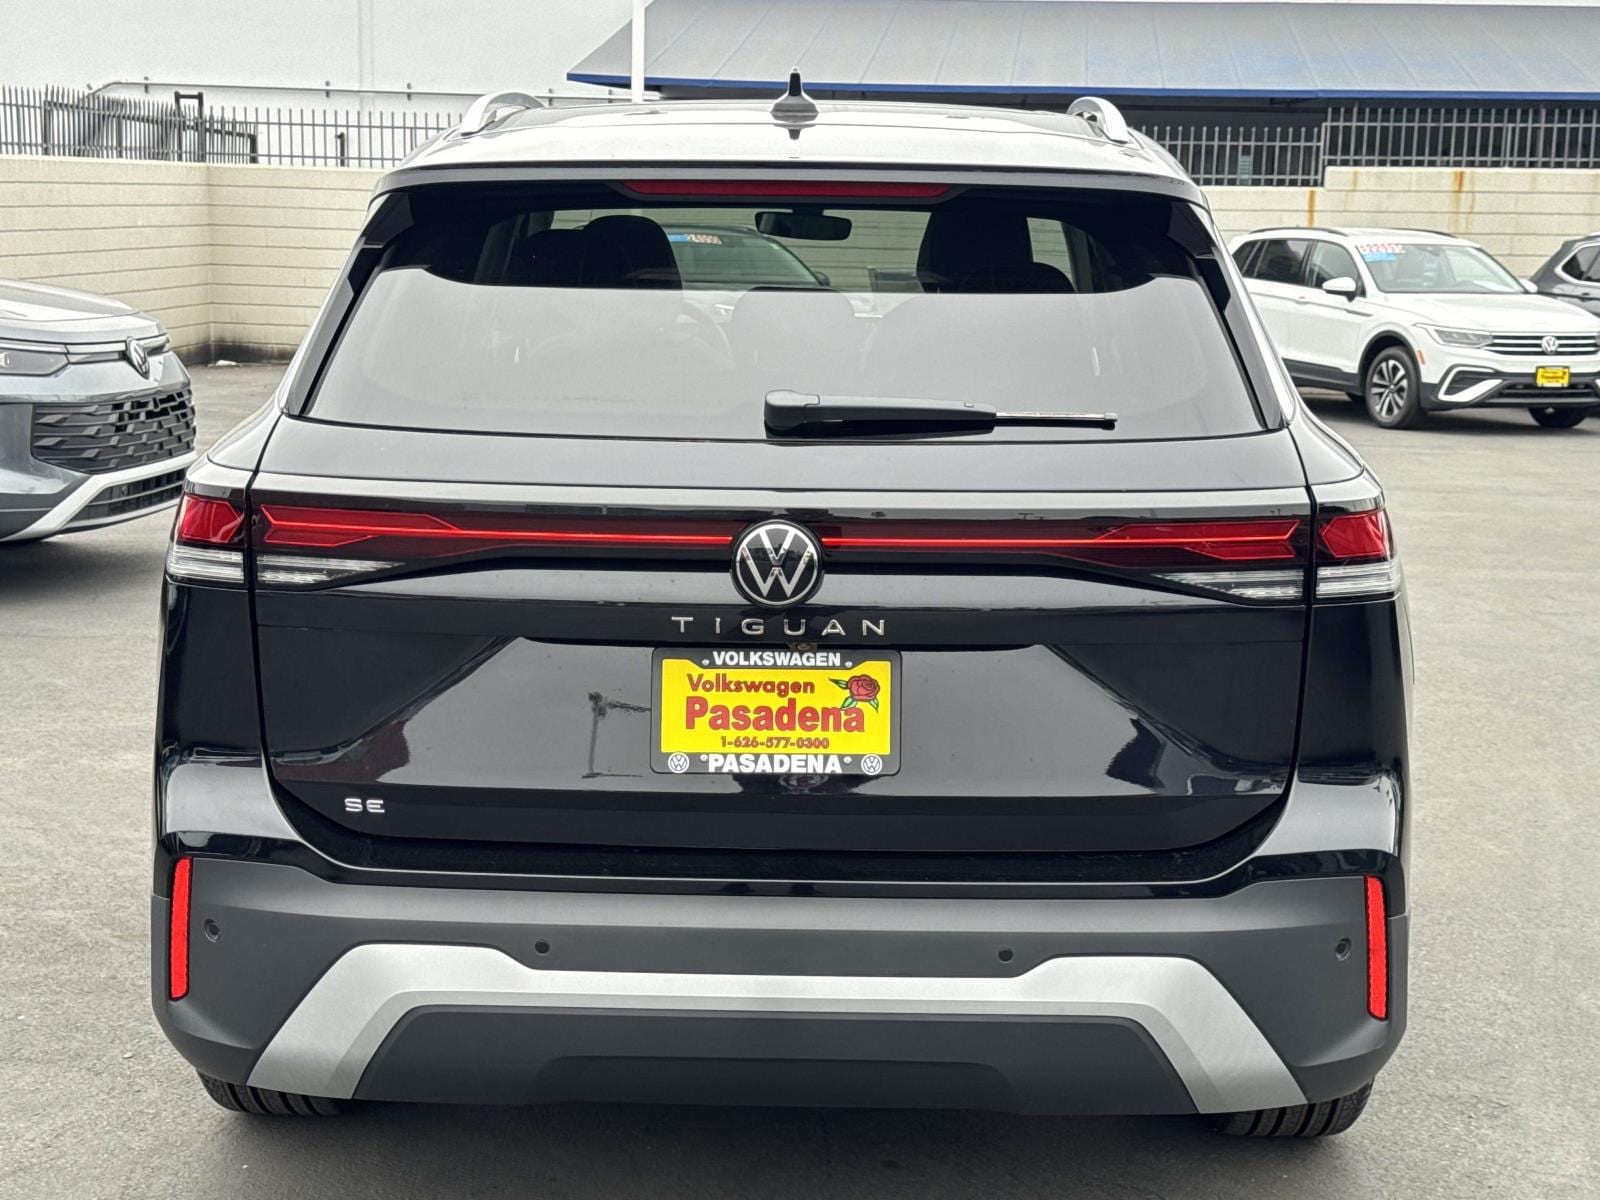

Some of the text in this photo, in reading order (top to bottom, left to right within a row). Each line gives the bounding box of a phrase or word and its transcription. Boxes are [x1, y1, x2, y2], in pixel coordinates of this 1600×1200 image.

[671, 616, 885, 637] TIGUAN
[713, 651, 841, 667] VOLKSWAGEN
[687, 673, 815, 698] Volkswagen
[685, 696, 866, 733] Pasadena
[720, 735, 830, 750] 1-626-577-0300
[708, 754, 842, 774] PASADENA
[344, 798, 386, 813] SE
